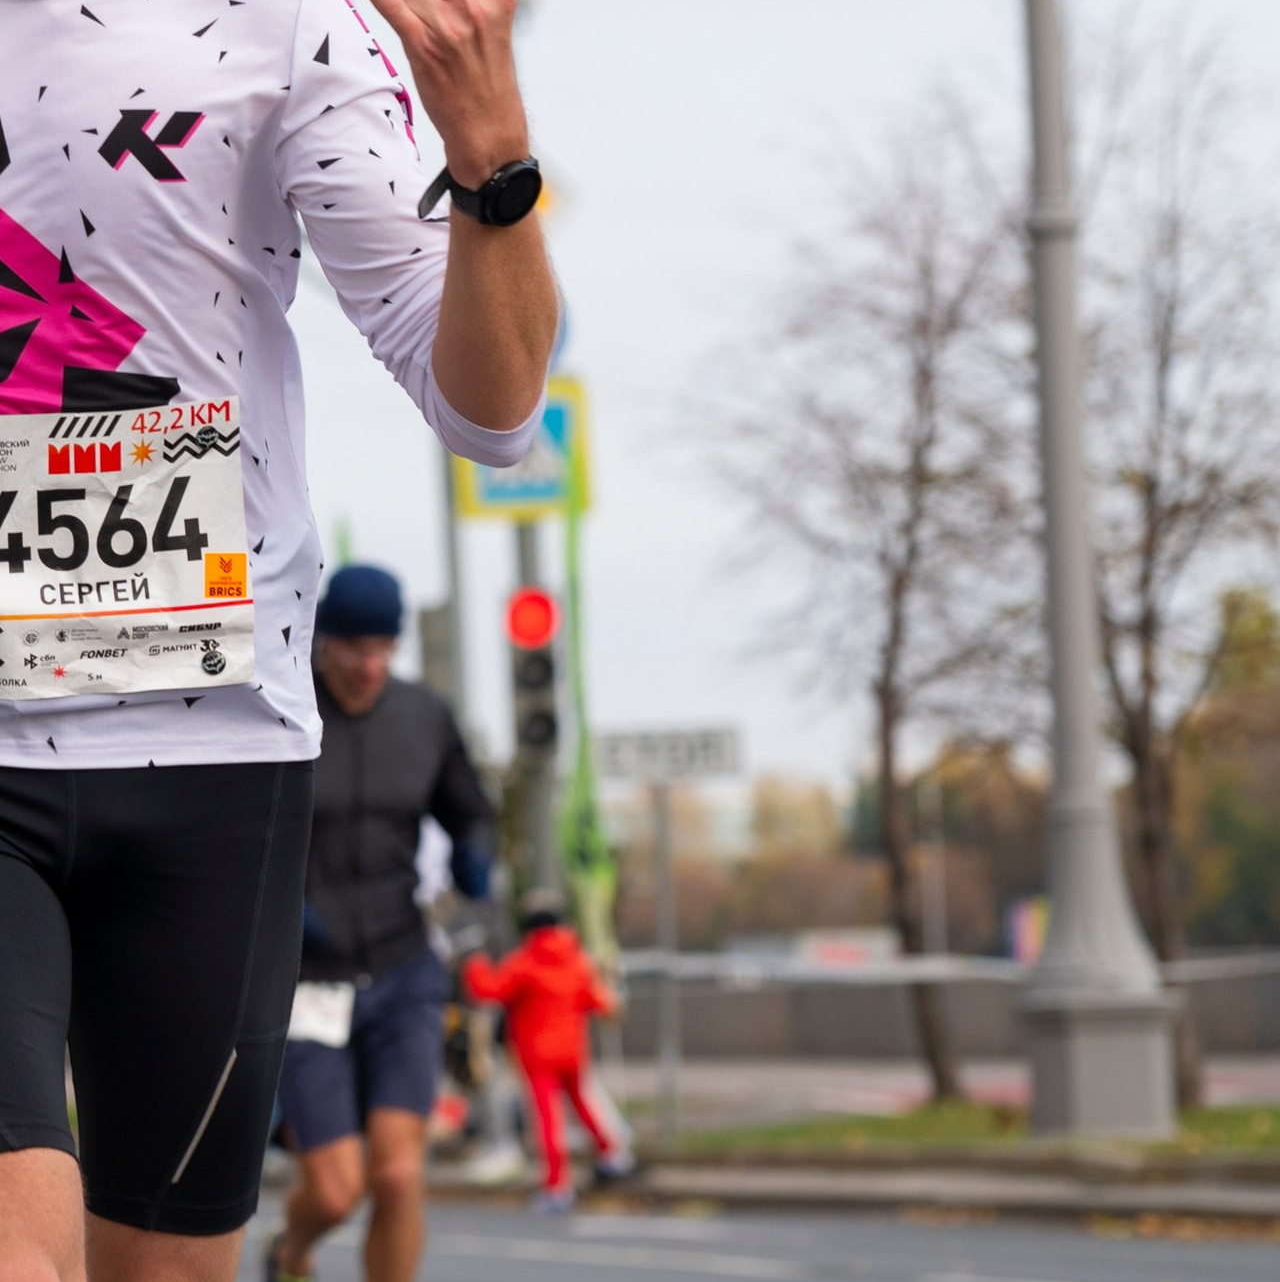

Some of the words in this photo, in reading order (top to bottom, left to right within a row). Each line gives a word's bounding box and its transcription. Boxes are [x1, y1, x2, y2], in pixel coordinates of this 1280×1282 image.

[131, 407, 184, 434] 42,2
[40, 572, 151, 605] СЕРГЕЙ
[209, 586, 243, 597] BRICS
[80, 648, 128, 660] FONBET
[162, 643, 198, 653] МАГНИТ
